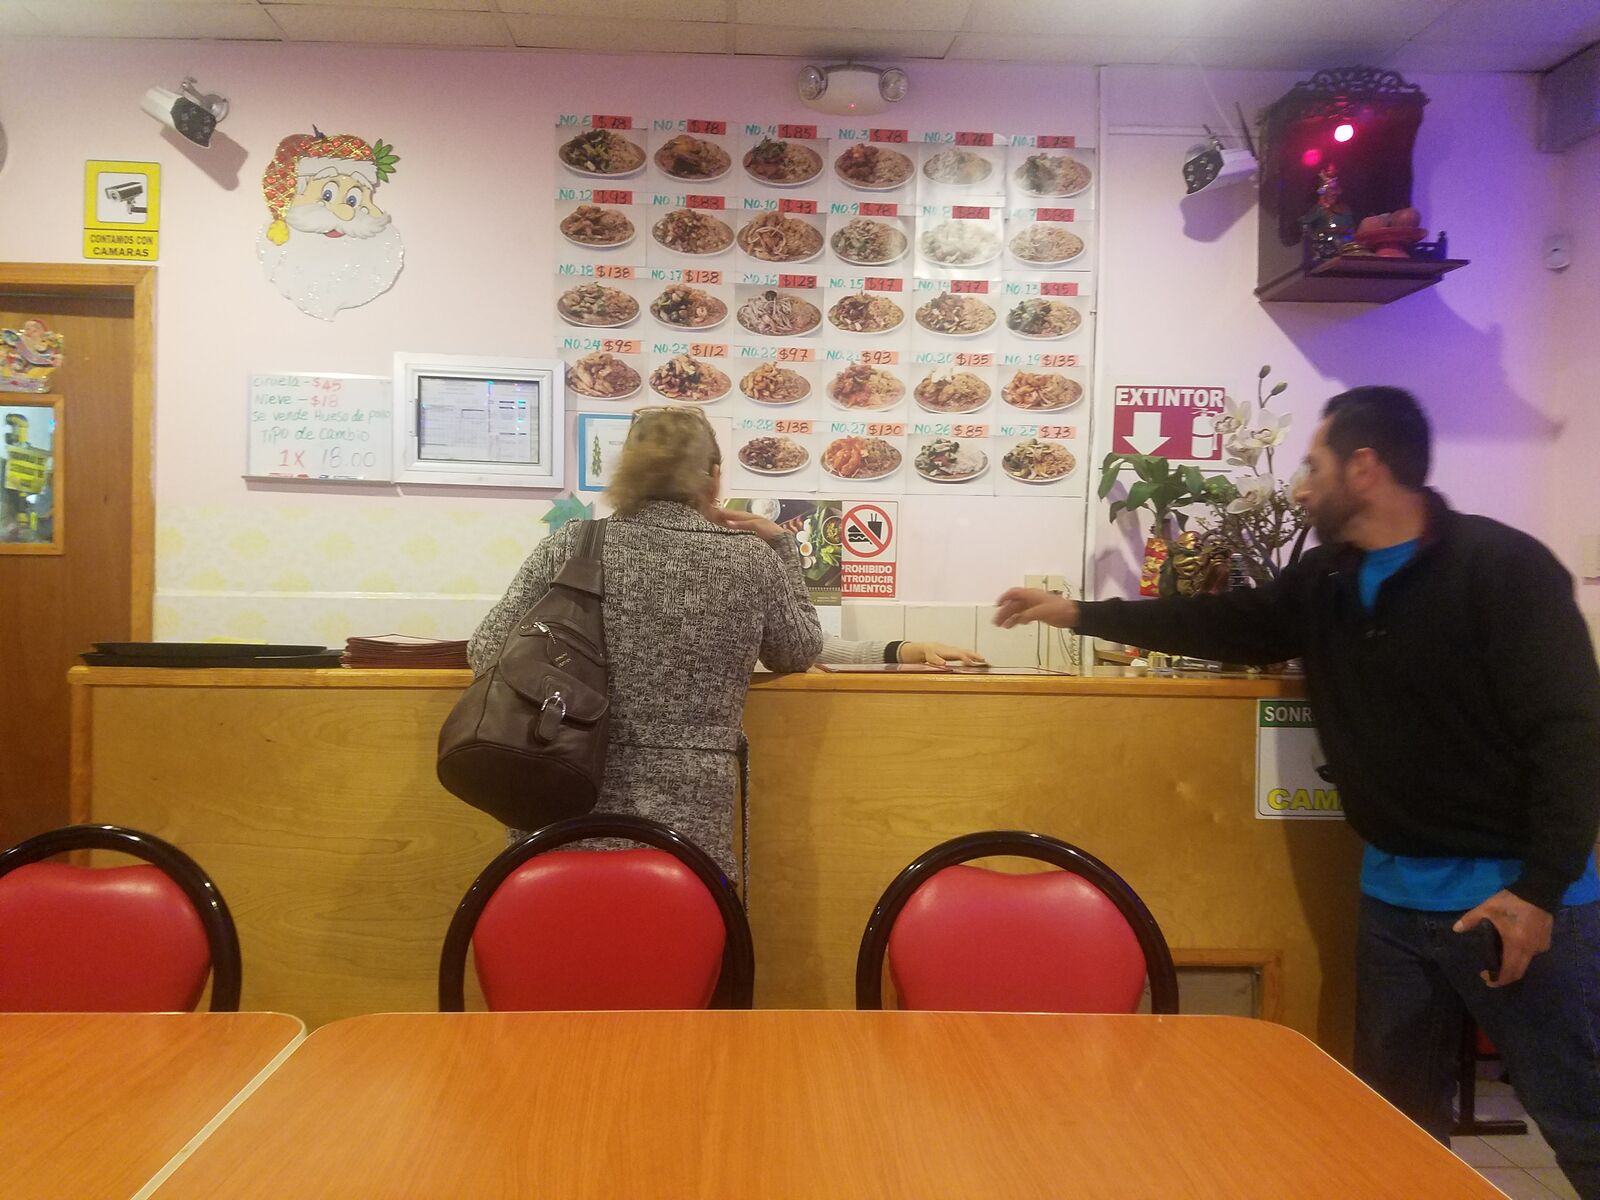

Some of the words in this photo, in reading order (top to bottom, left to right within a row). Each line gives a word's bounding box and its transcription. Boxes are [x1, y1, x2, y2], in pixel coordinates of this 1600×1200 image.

[559, 189, 592, 200] NO.12
[744, 198, 777, 211] NO.10
[830, 203, 860, 214] NO.9
[90, 234, 134, 244] CONTAMOS
[136, 235, 153, 245] CON
[93, 247, 149, 257] CAMARAS
[596, 265, 631, 279] $138
[686, 270, 720, 284] $138
[564, 338, 601, 349] NO.24
[603, 339, 632, 353] $95
[691, 344, 725, 357] $112
[741, 347, 776, 359] NO.22
[779, 348, 808, 362] $97
[862, 351, 892, 364] $93
[956, 353, 989, 366] $135
[1042, 354, 1077, 367] $135
[1115, 387, 1224, 408] EXTINTOR
[775, 421, 809, 433] $138
[831, 422, 866, 433] NO.27
[869, 424, 901, 436] $130
[954, 425, 984, 437] $85
[1041, 426, 1071, 438] $73
[1266, 788, 1344, 811] CAM
